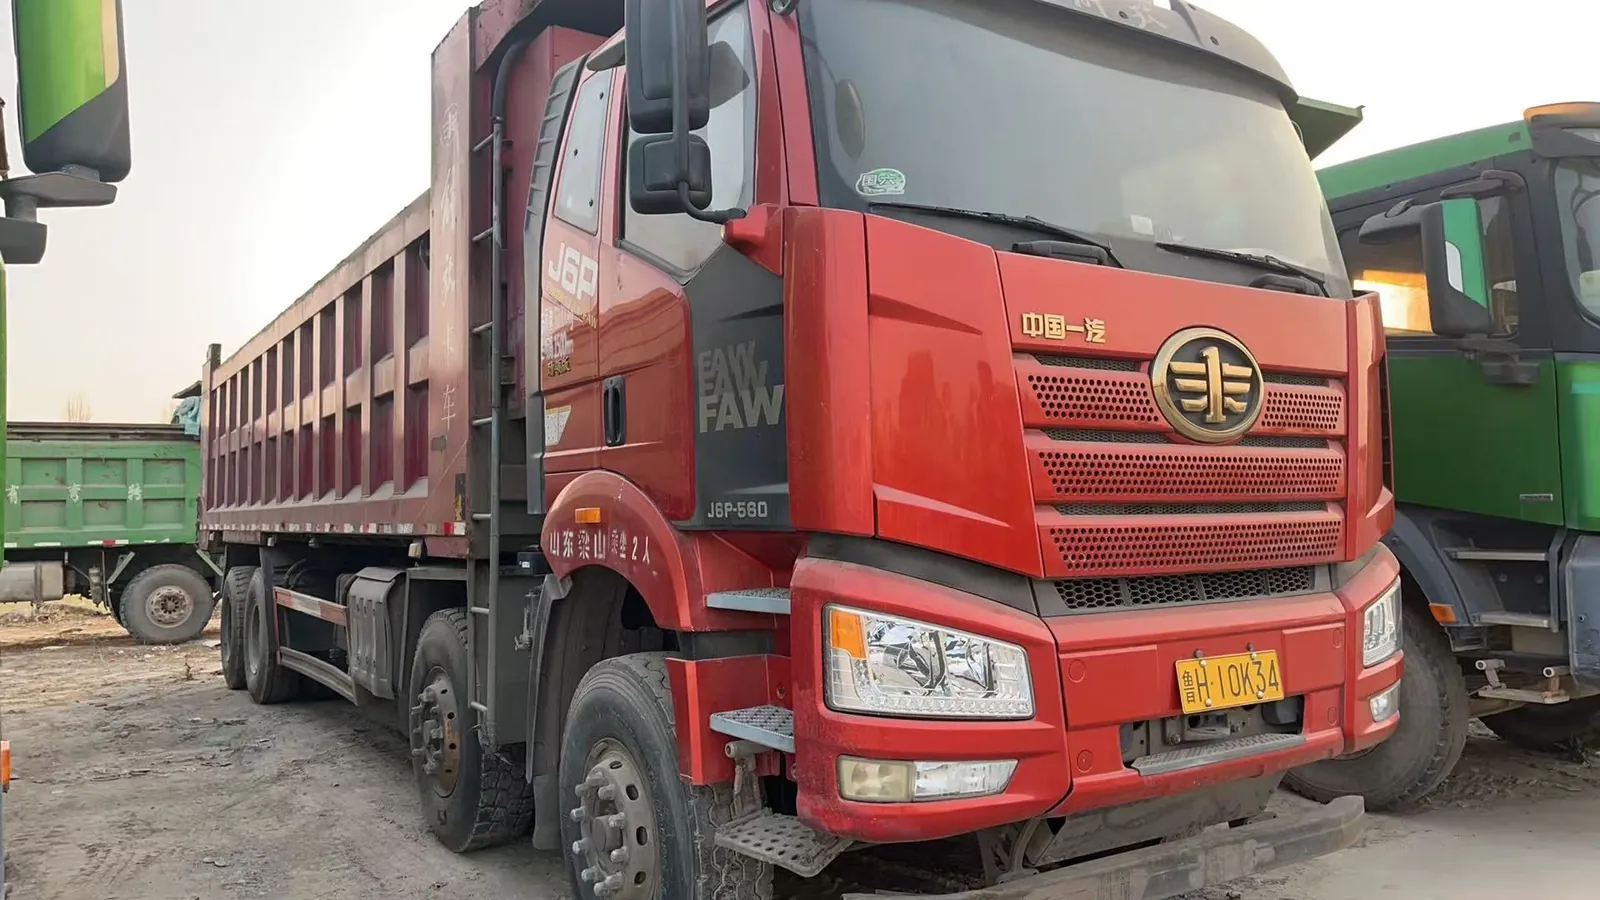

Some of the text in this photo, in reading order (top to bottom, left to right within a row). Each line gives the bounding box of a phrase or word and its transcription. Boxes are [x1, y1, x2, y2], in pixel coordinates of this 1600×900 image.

[548, 242, 599, 300] J6P
[1022, 312, 1106, 343] 中国一汽
[699, 384, 784, 433] FAW
[707, 501, 768, 518] J6P-560
